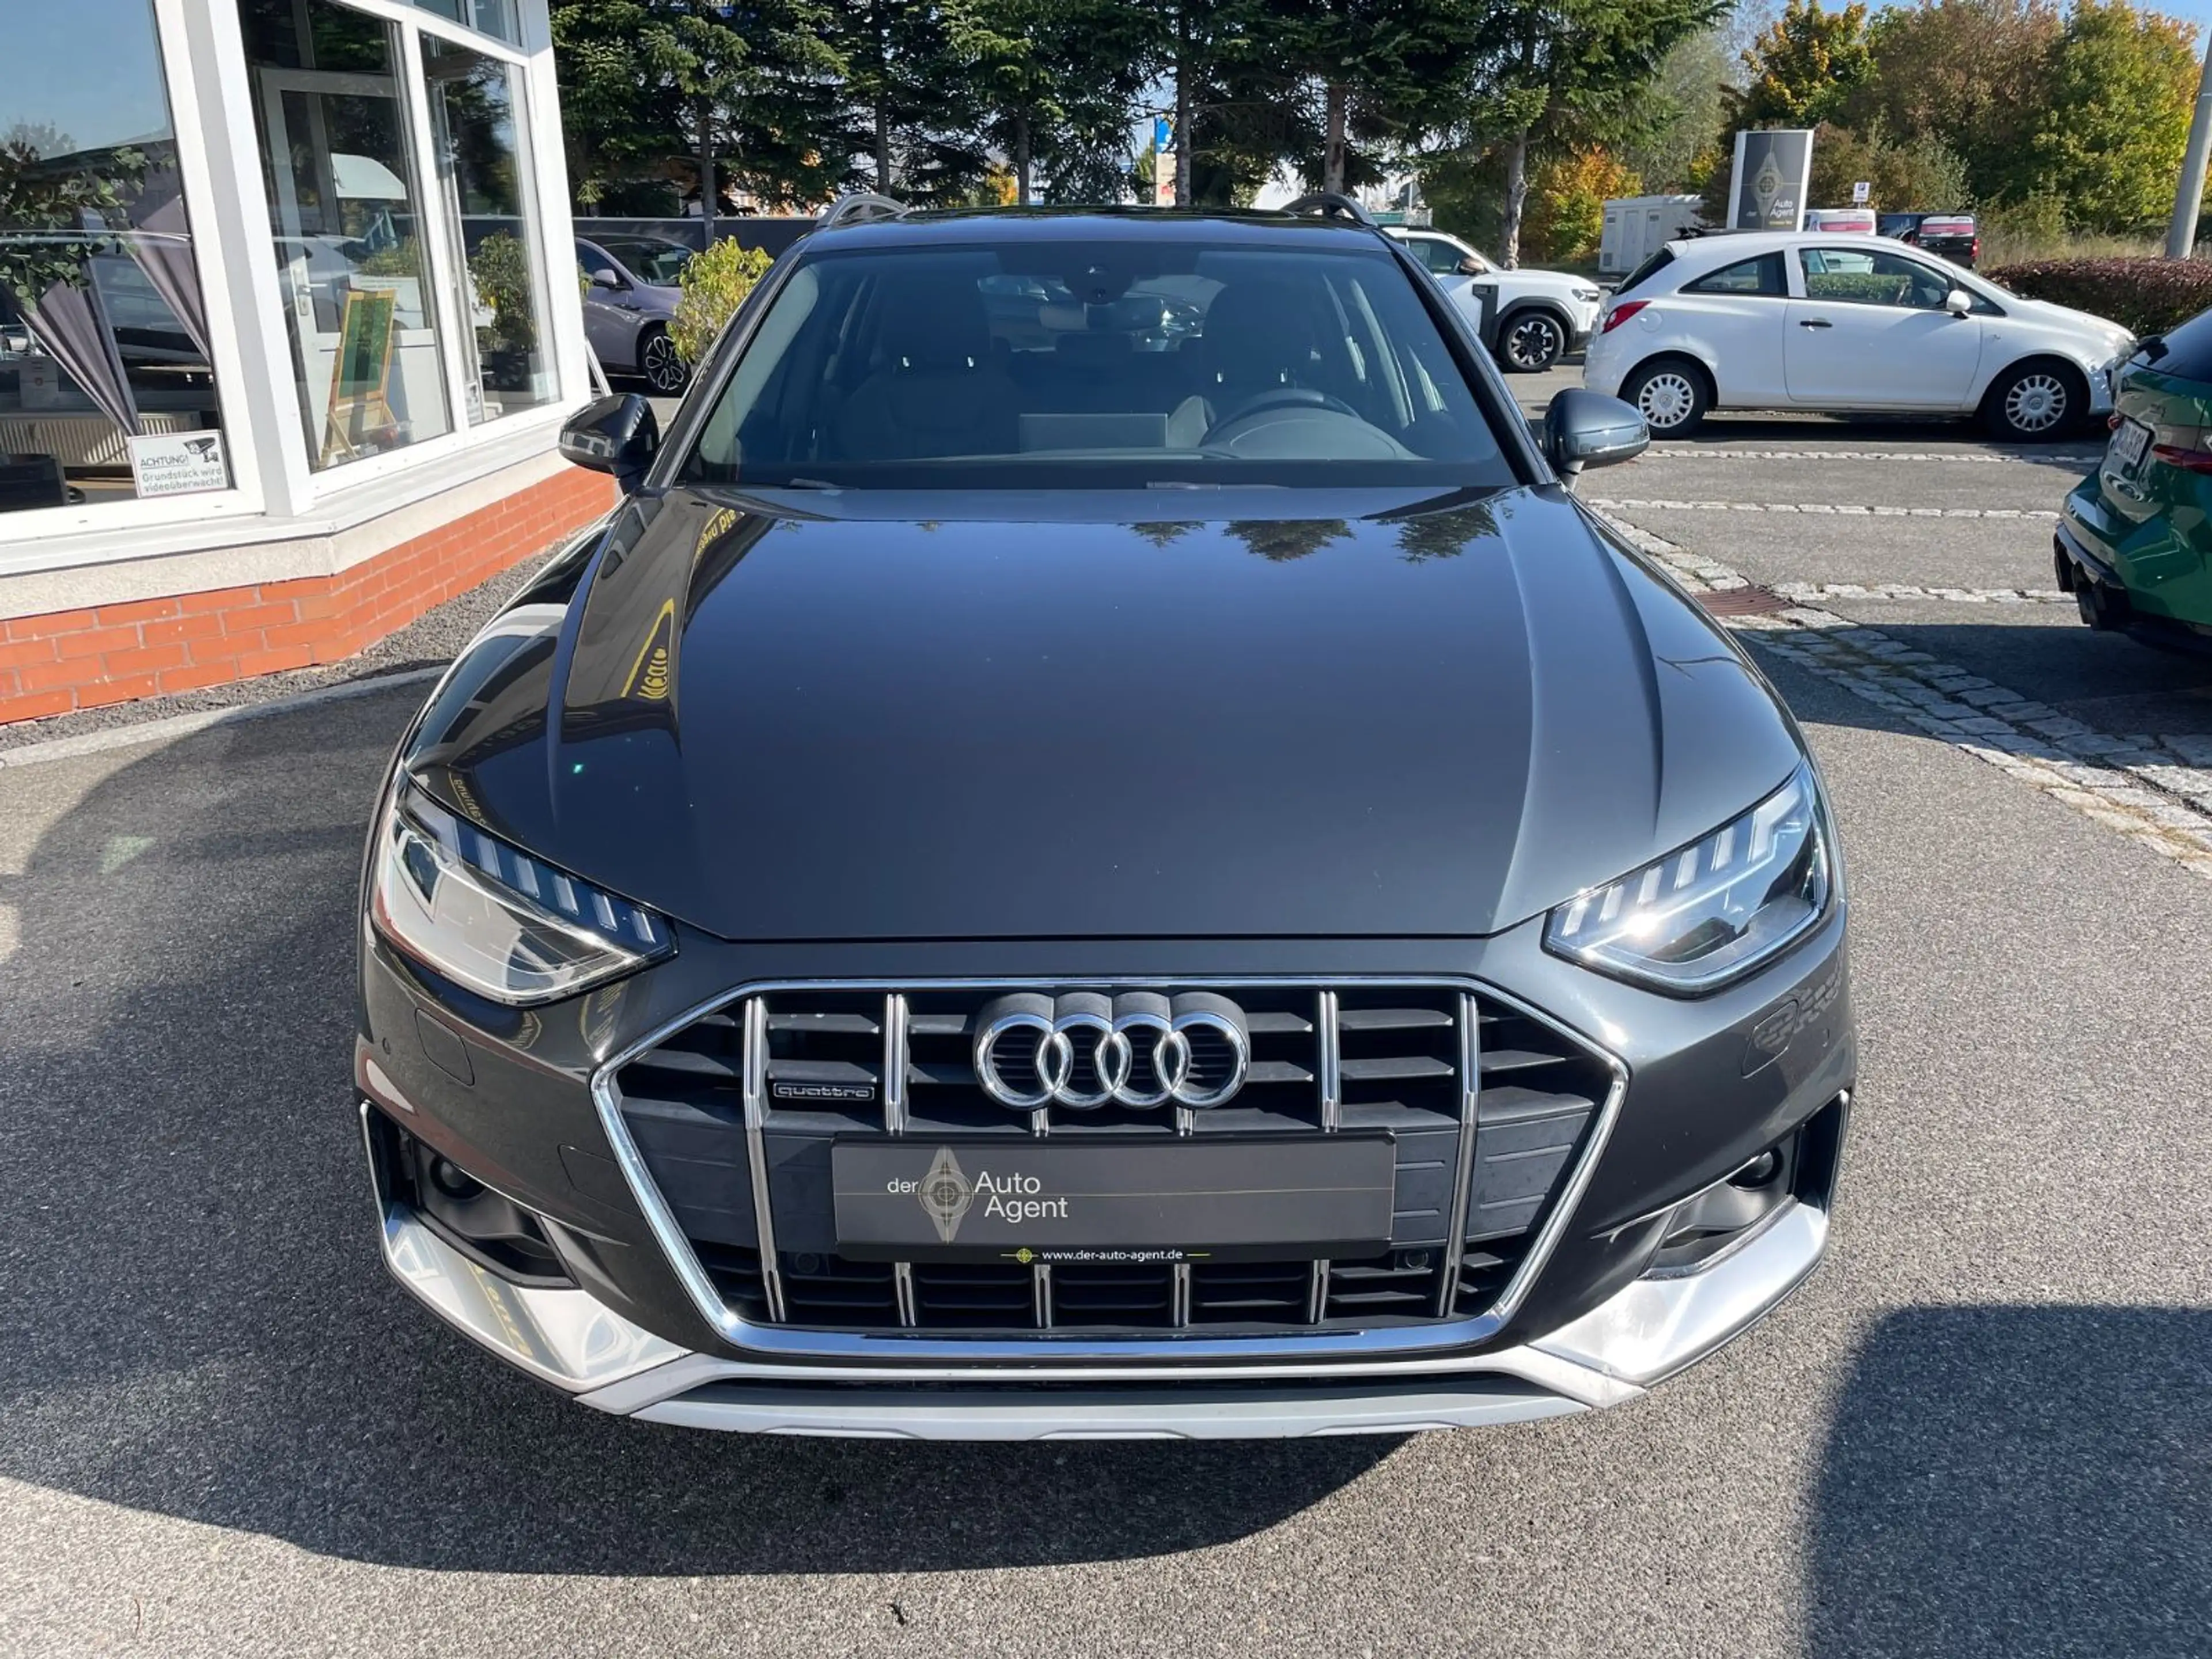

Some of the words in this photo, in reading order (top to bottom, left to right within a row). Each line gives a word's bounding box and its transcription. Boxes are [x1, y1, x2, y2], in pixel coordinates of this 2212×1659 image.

[1774, 199, 1793, 208] Auto
[1770, 208, 1794, 218] Agent
[141, 454, 188, 467] ACHTUNG!
[142, 468, 199, 483] Grundstück
[200, 468, 222, 477] wird
[144, 477, 224, 492] videoüberwacht!
[778, 1086, 870, 1097] quattro
[887, 1178, 918, 1194] der
[974, 1171, 1041, 1194] Auto
[984, 1196, 1068, 1224] Agent
[1041, 1250, 1183, 1261] www.der-auto-agent.de
